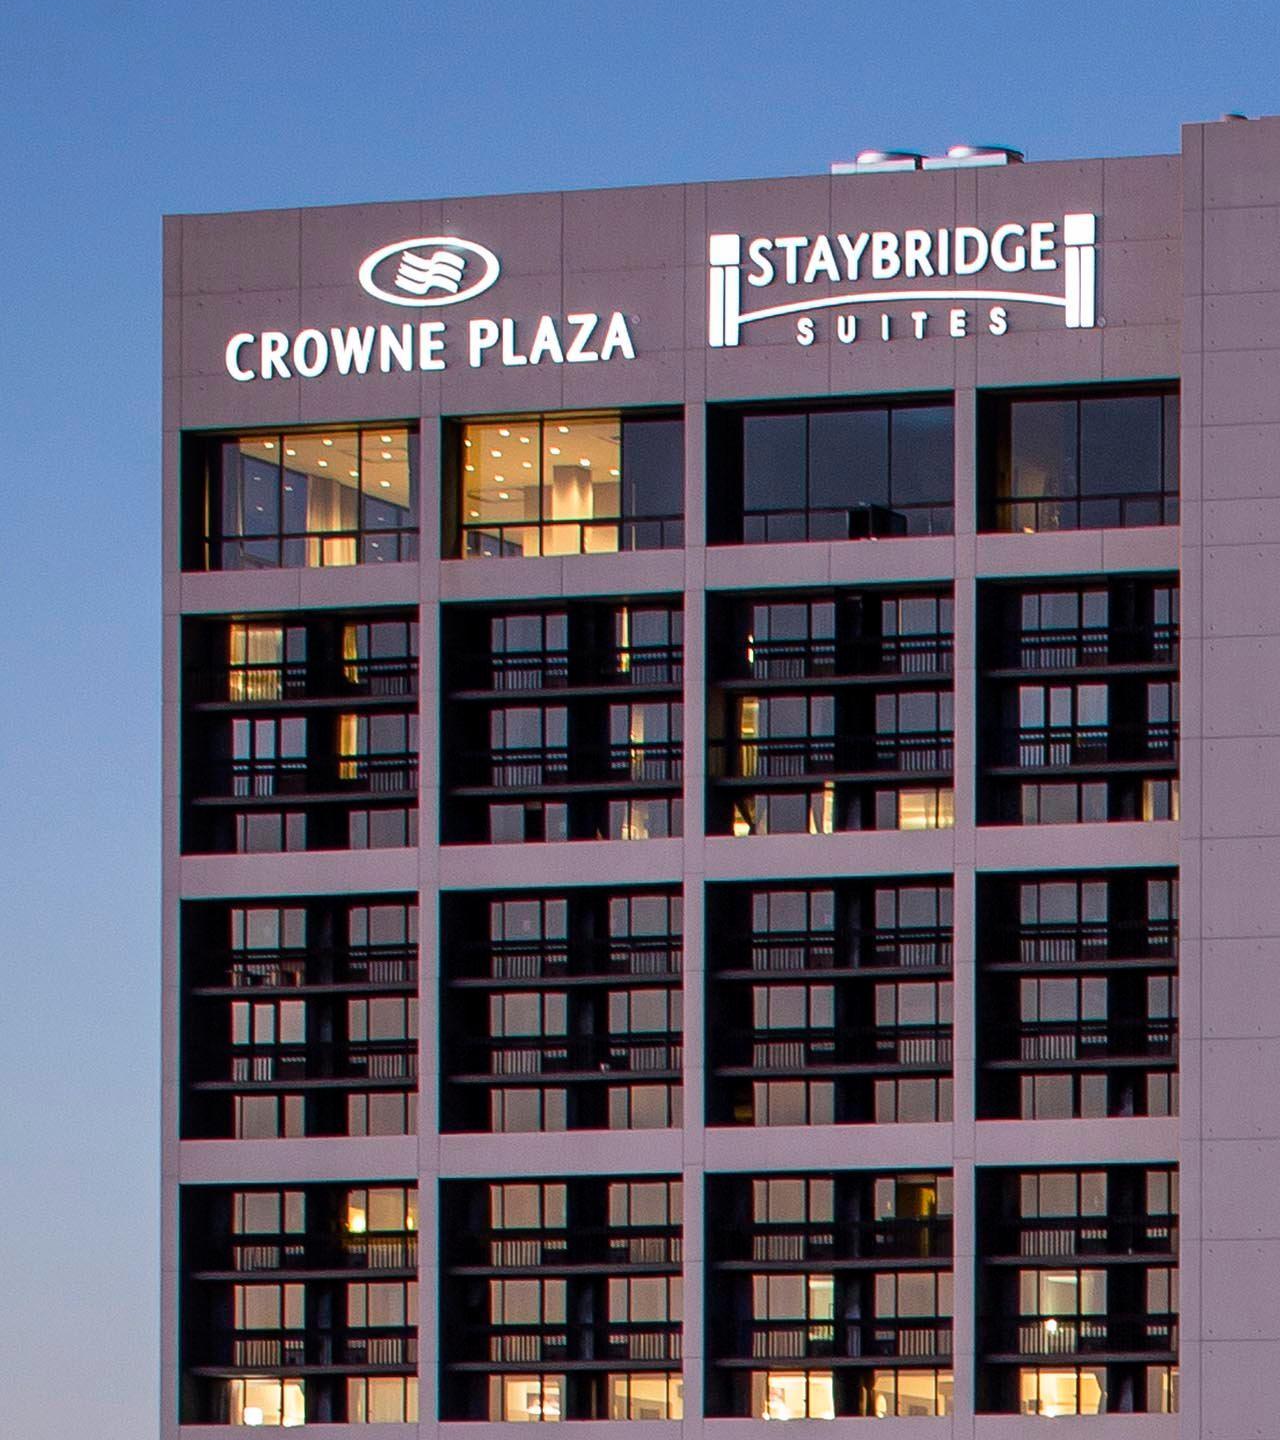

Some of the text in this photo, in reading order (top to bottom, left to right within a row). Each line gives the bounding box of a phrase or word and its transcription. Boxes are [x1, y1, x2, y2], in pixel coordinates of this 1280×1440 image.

[746, 221, 1058, 287] STAYBRIDGE
[224, 310, 636, 382] CROWNE PLAZA
[795, 305, 1008, 347] SUITES
